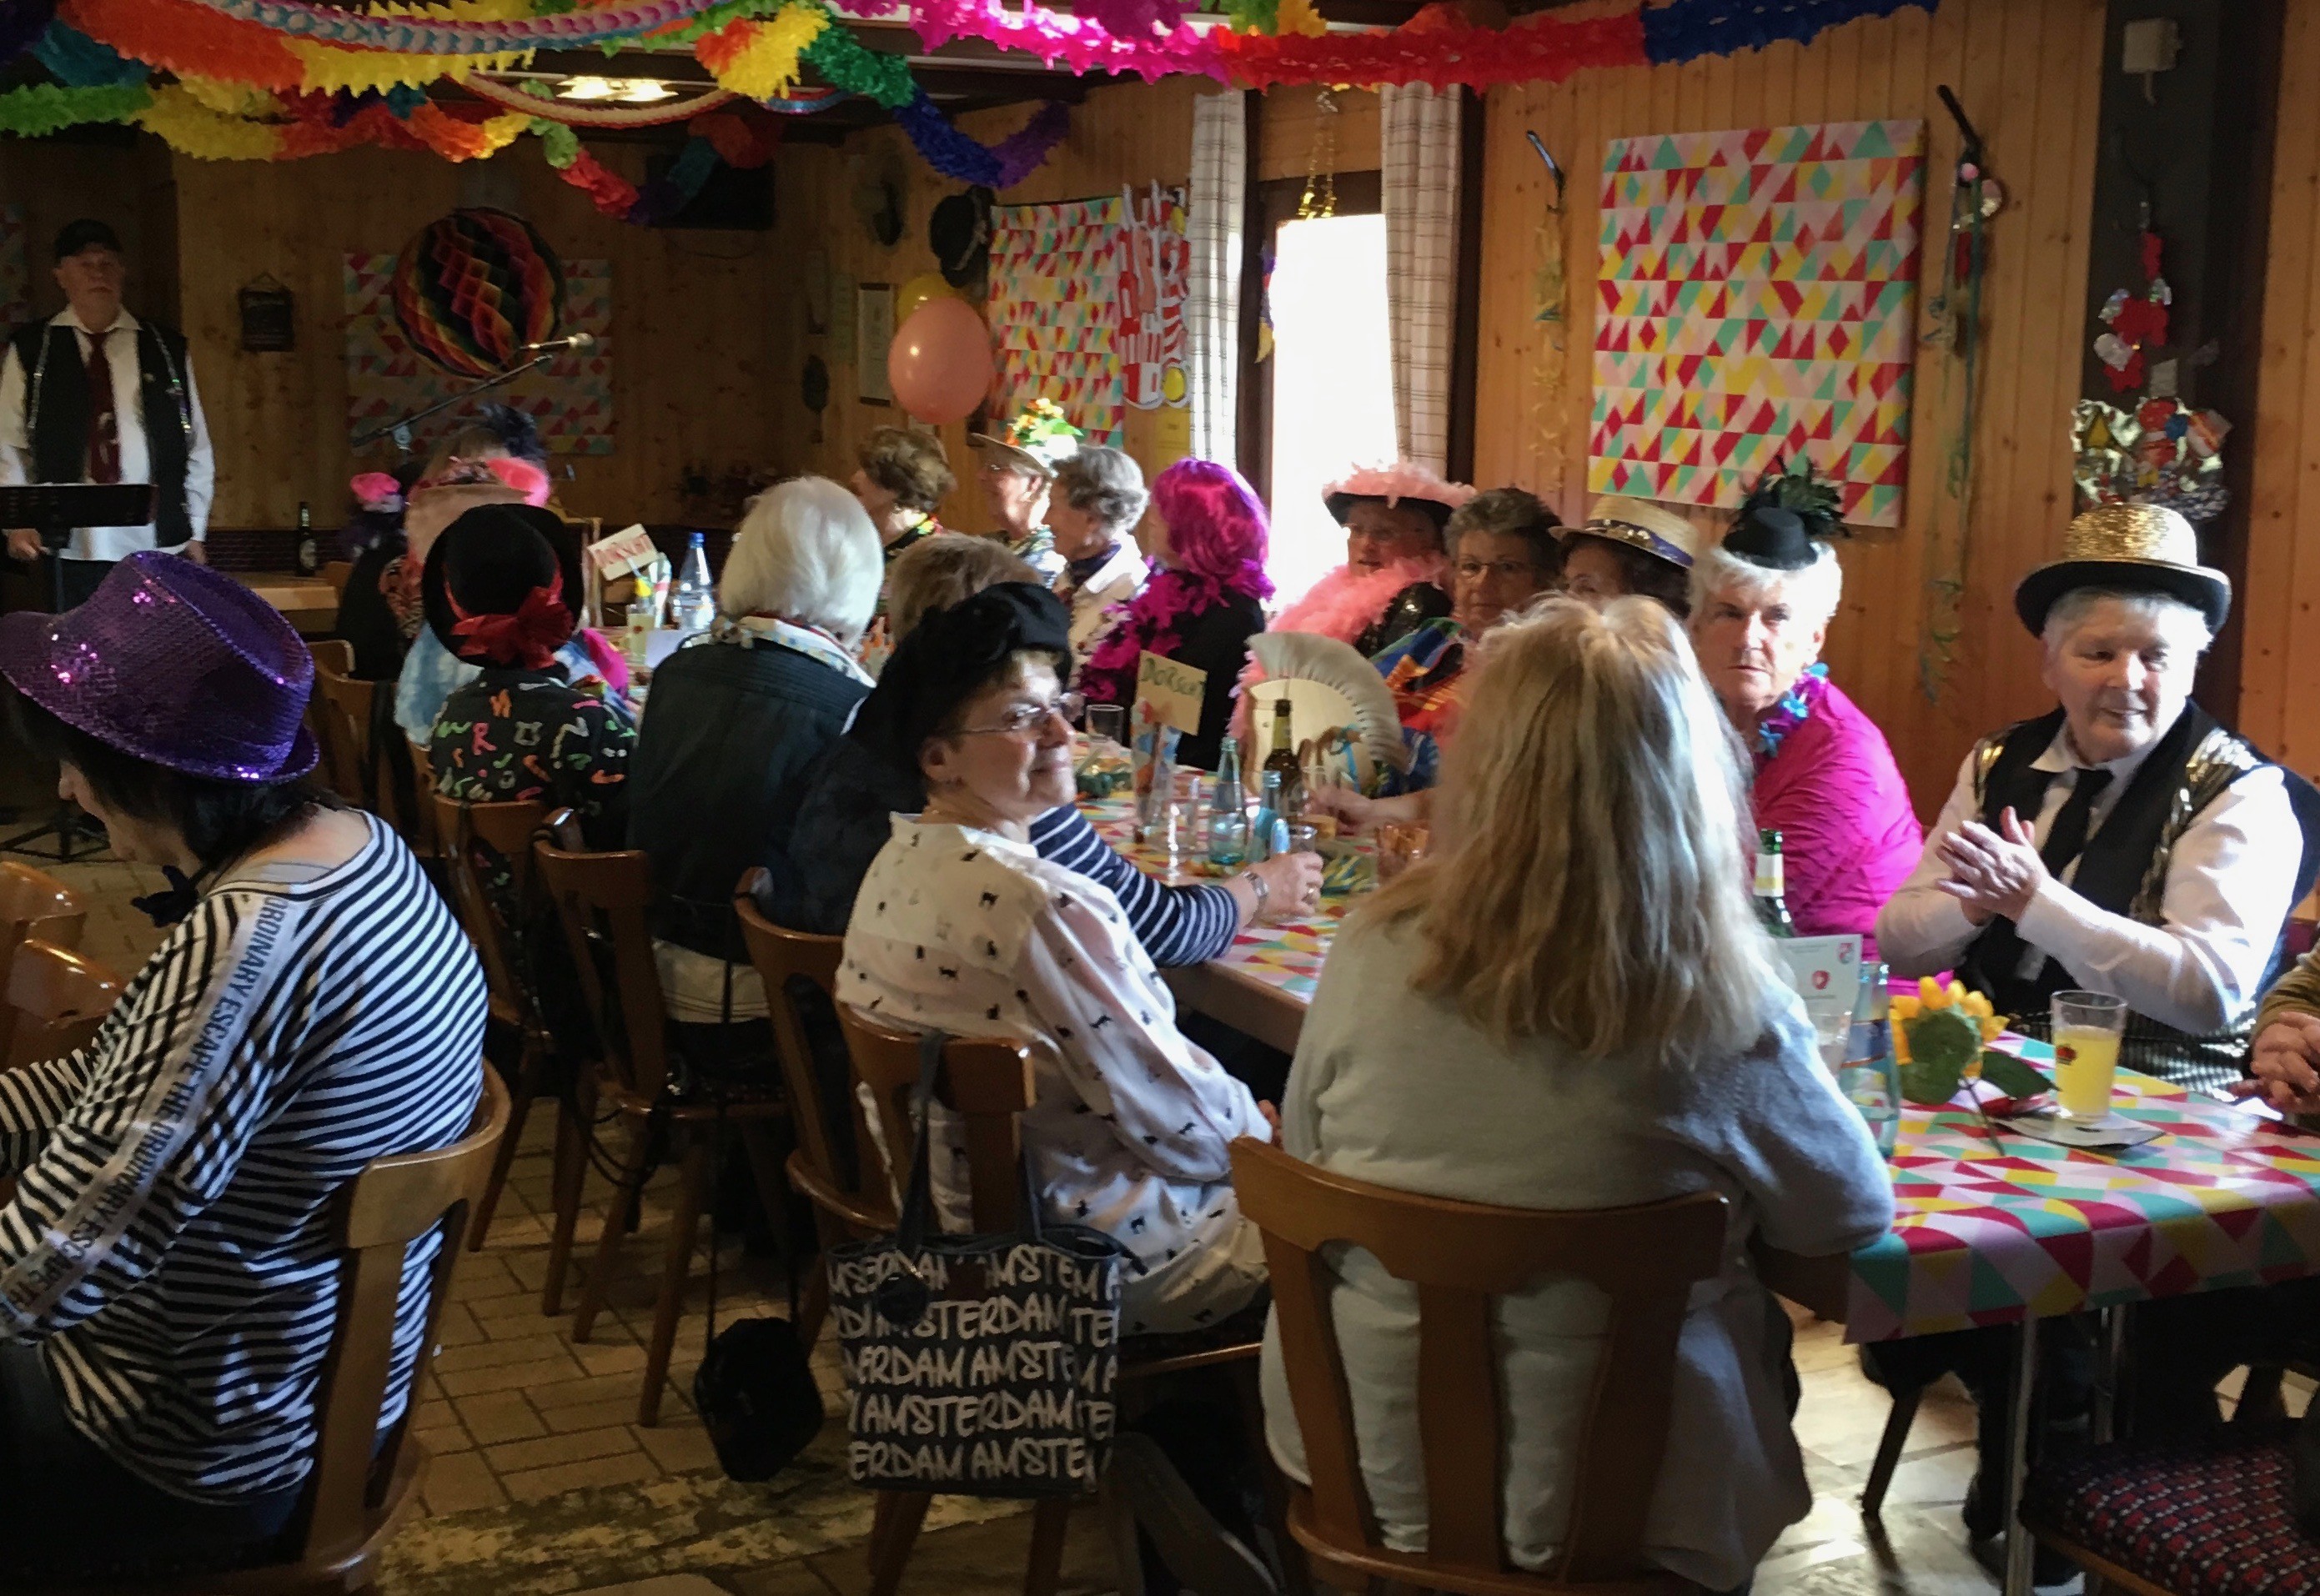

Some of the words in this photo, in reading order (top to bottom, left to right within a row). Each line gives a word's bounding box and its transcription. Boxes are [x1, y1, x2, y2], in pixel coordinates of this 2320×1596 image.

[228, 897, 289, 996] ORDINARY
[183, 998, 240, 1081] ESCAPE
[154, 1077, 198, 1128] THE
[862, 1388, 1075, 1438] AMSTERDAM
